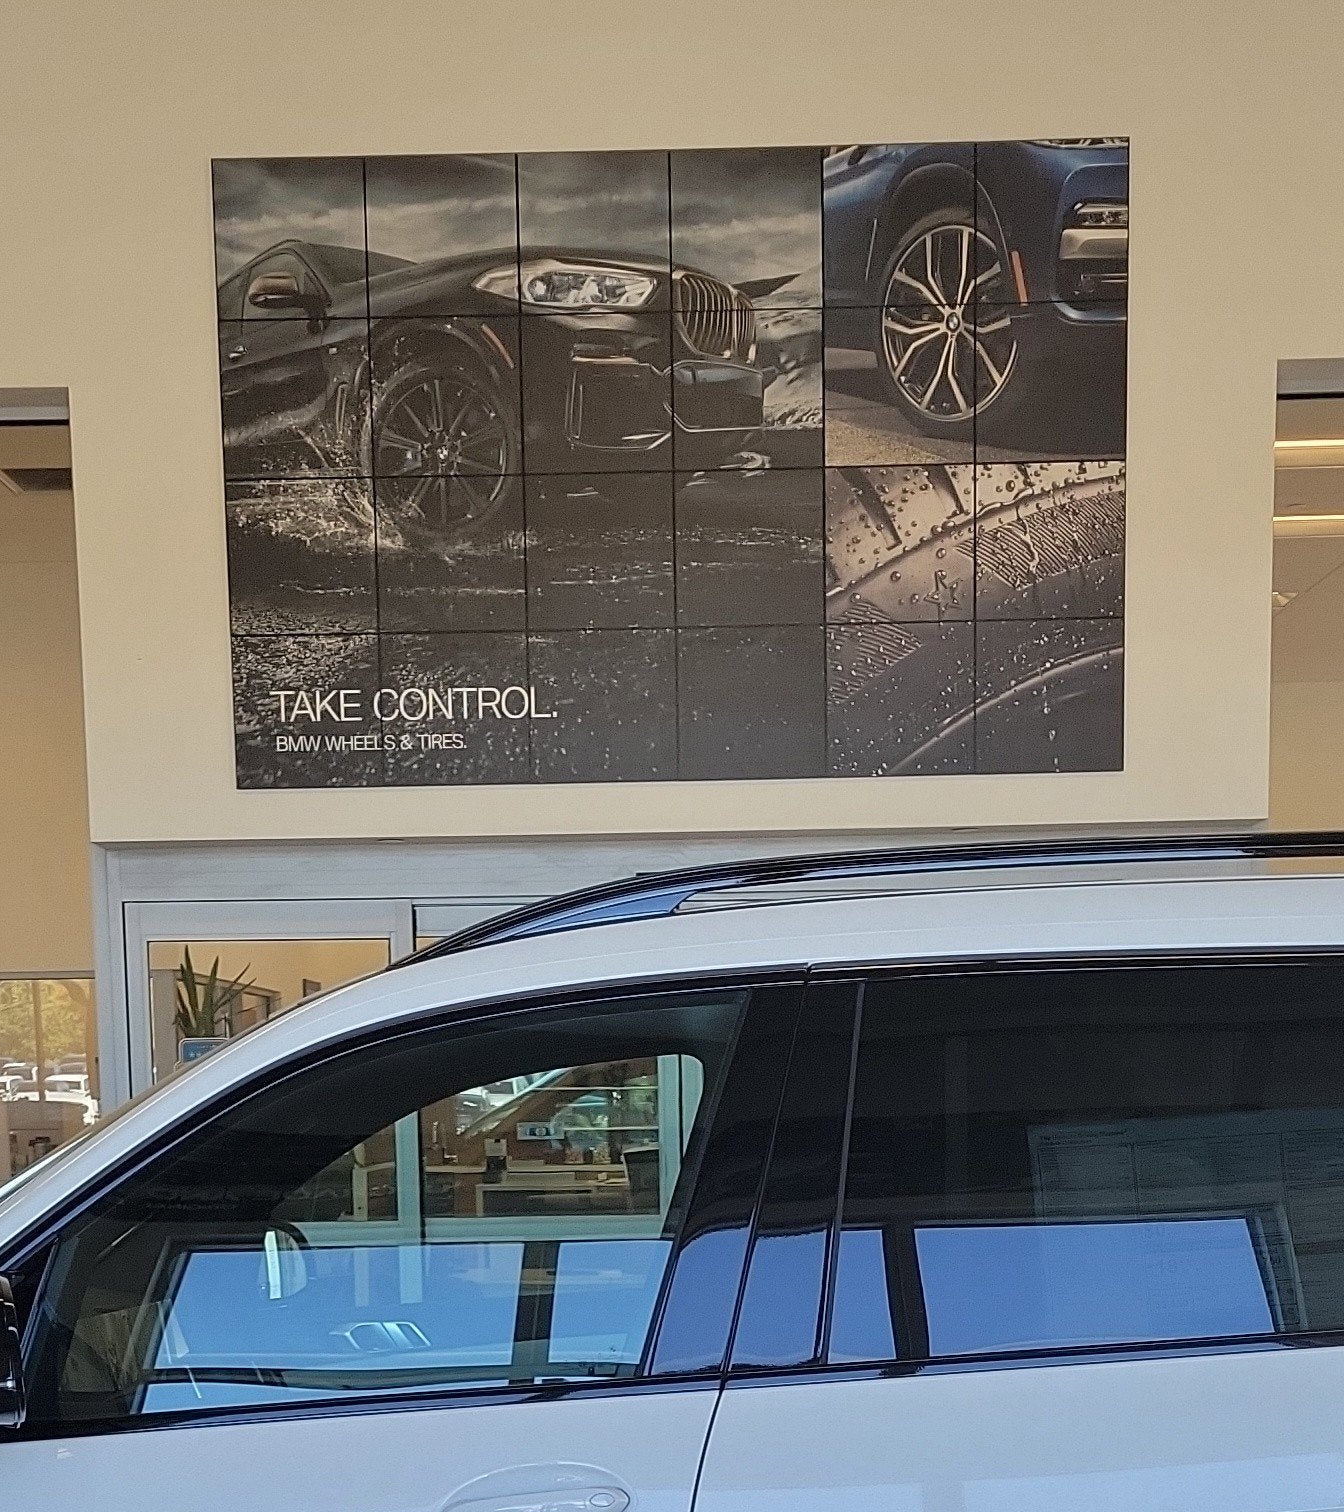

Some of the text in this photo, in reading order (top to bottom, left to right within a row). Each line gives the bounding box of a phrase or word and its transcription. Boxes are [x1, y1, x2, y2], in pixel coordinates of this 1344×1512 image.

[268, 686, 558, 722] TAKE CONTROL.
[275, 735, 322, 752] BMW
[399, 733, 413, 751] &
[417, 733, 468, 750] TIRES.
